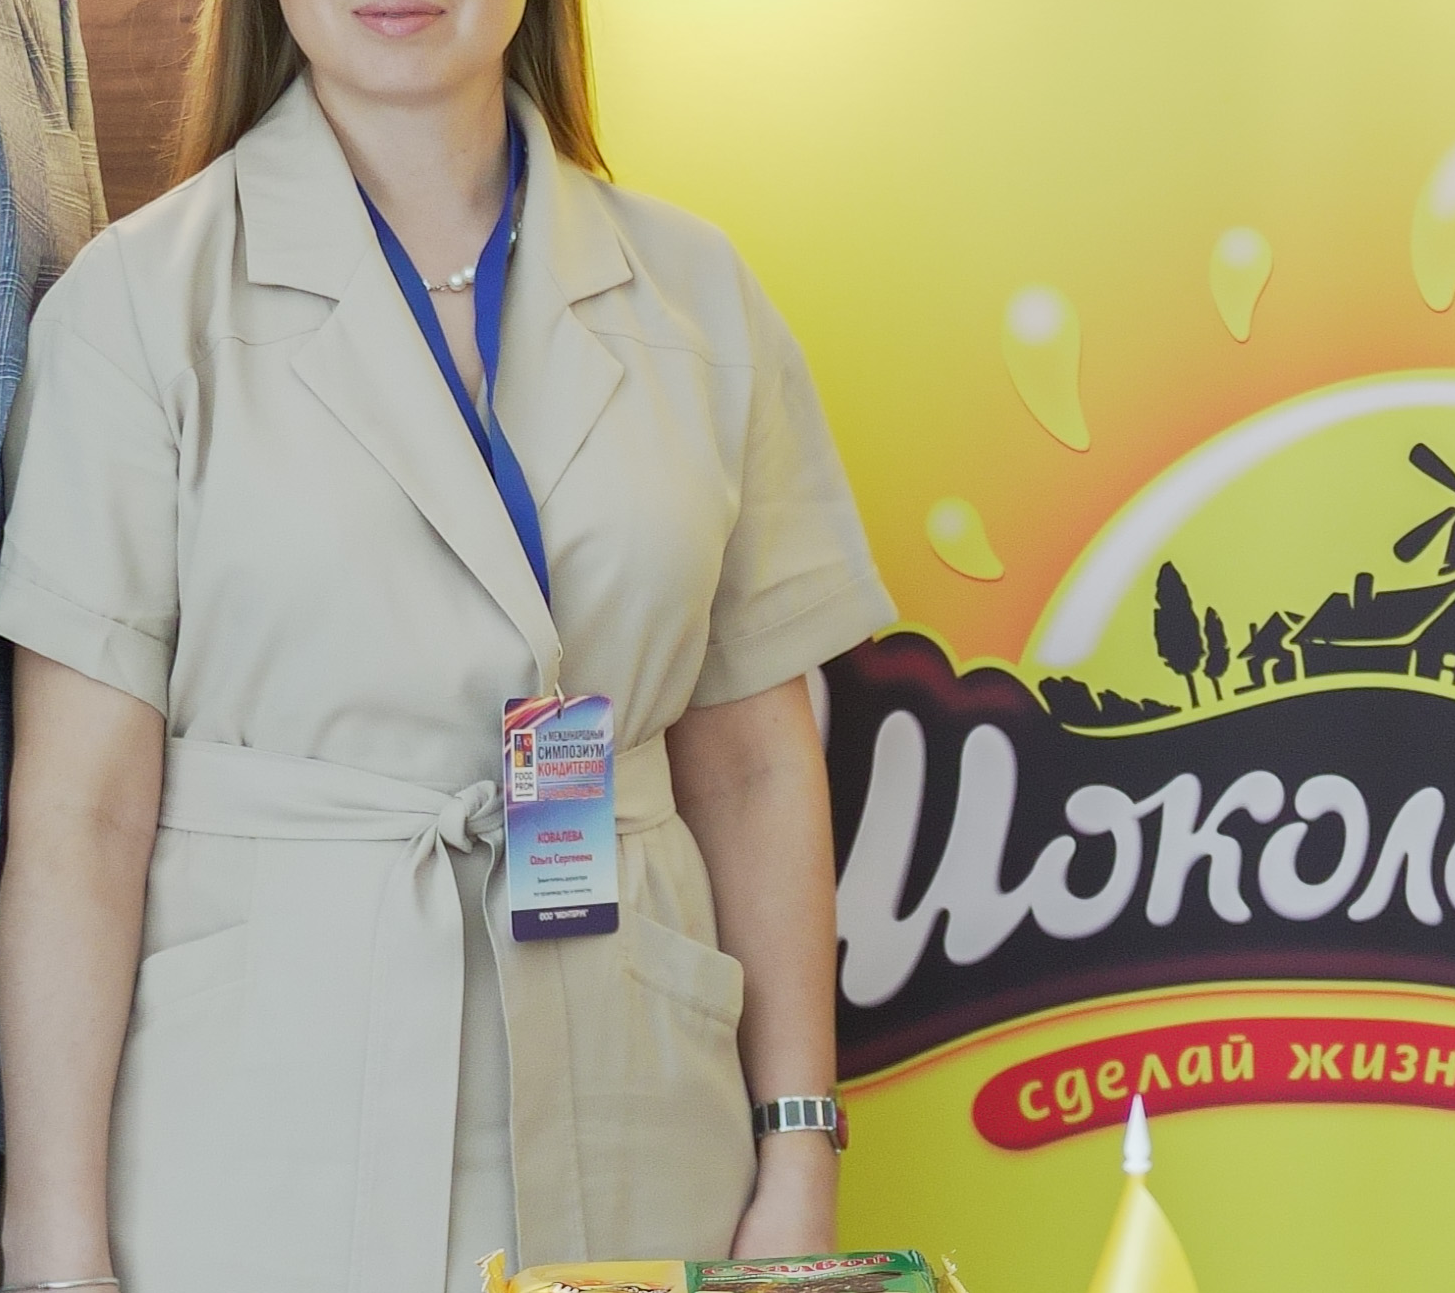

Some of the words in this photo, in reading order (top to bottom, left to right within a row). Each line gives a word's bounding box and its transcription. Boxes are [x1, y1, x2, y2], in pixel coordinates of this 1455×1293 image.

[538, 743, 605, 760] СИМПОЗИУМ
[538, 760, 606, 777] КОНДИТЕРОВ
[515, 772, 533, 781] FOOD
[515, 782, 534, 791] PROM
[537, 831, 583, 844] КОВАЛЕВА
[1016, 1039, 1256, 1126] сделай
